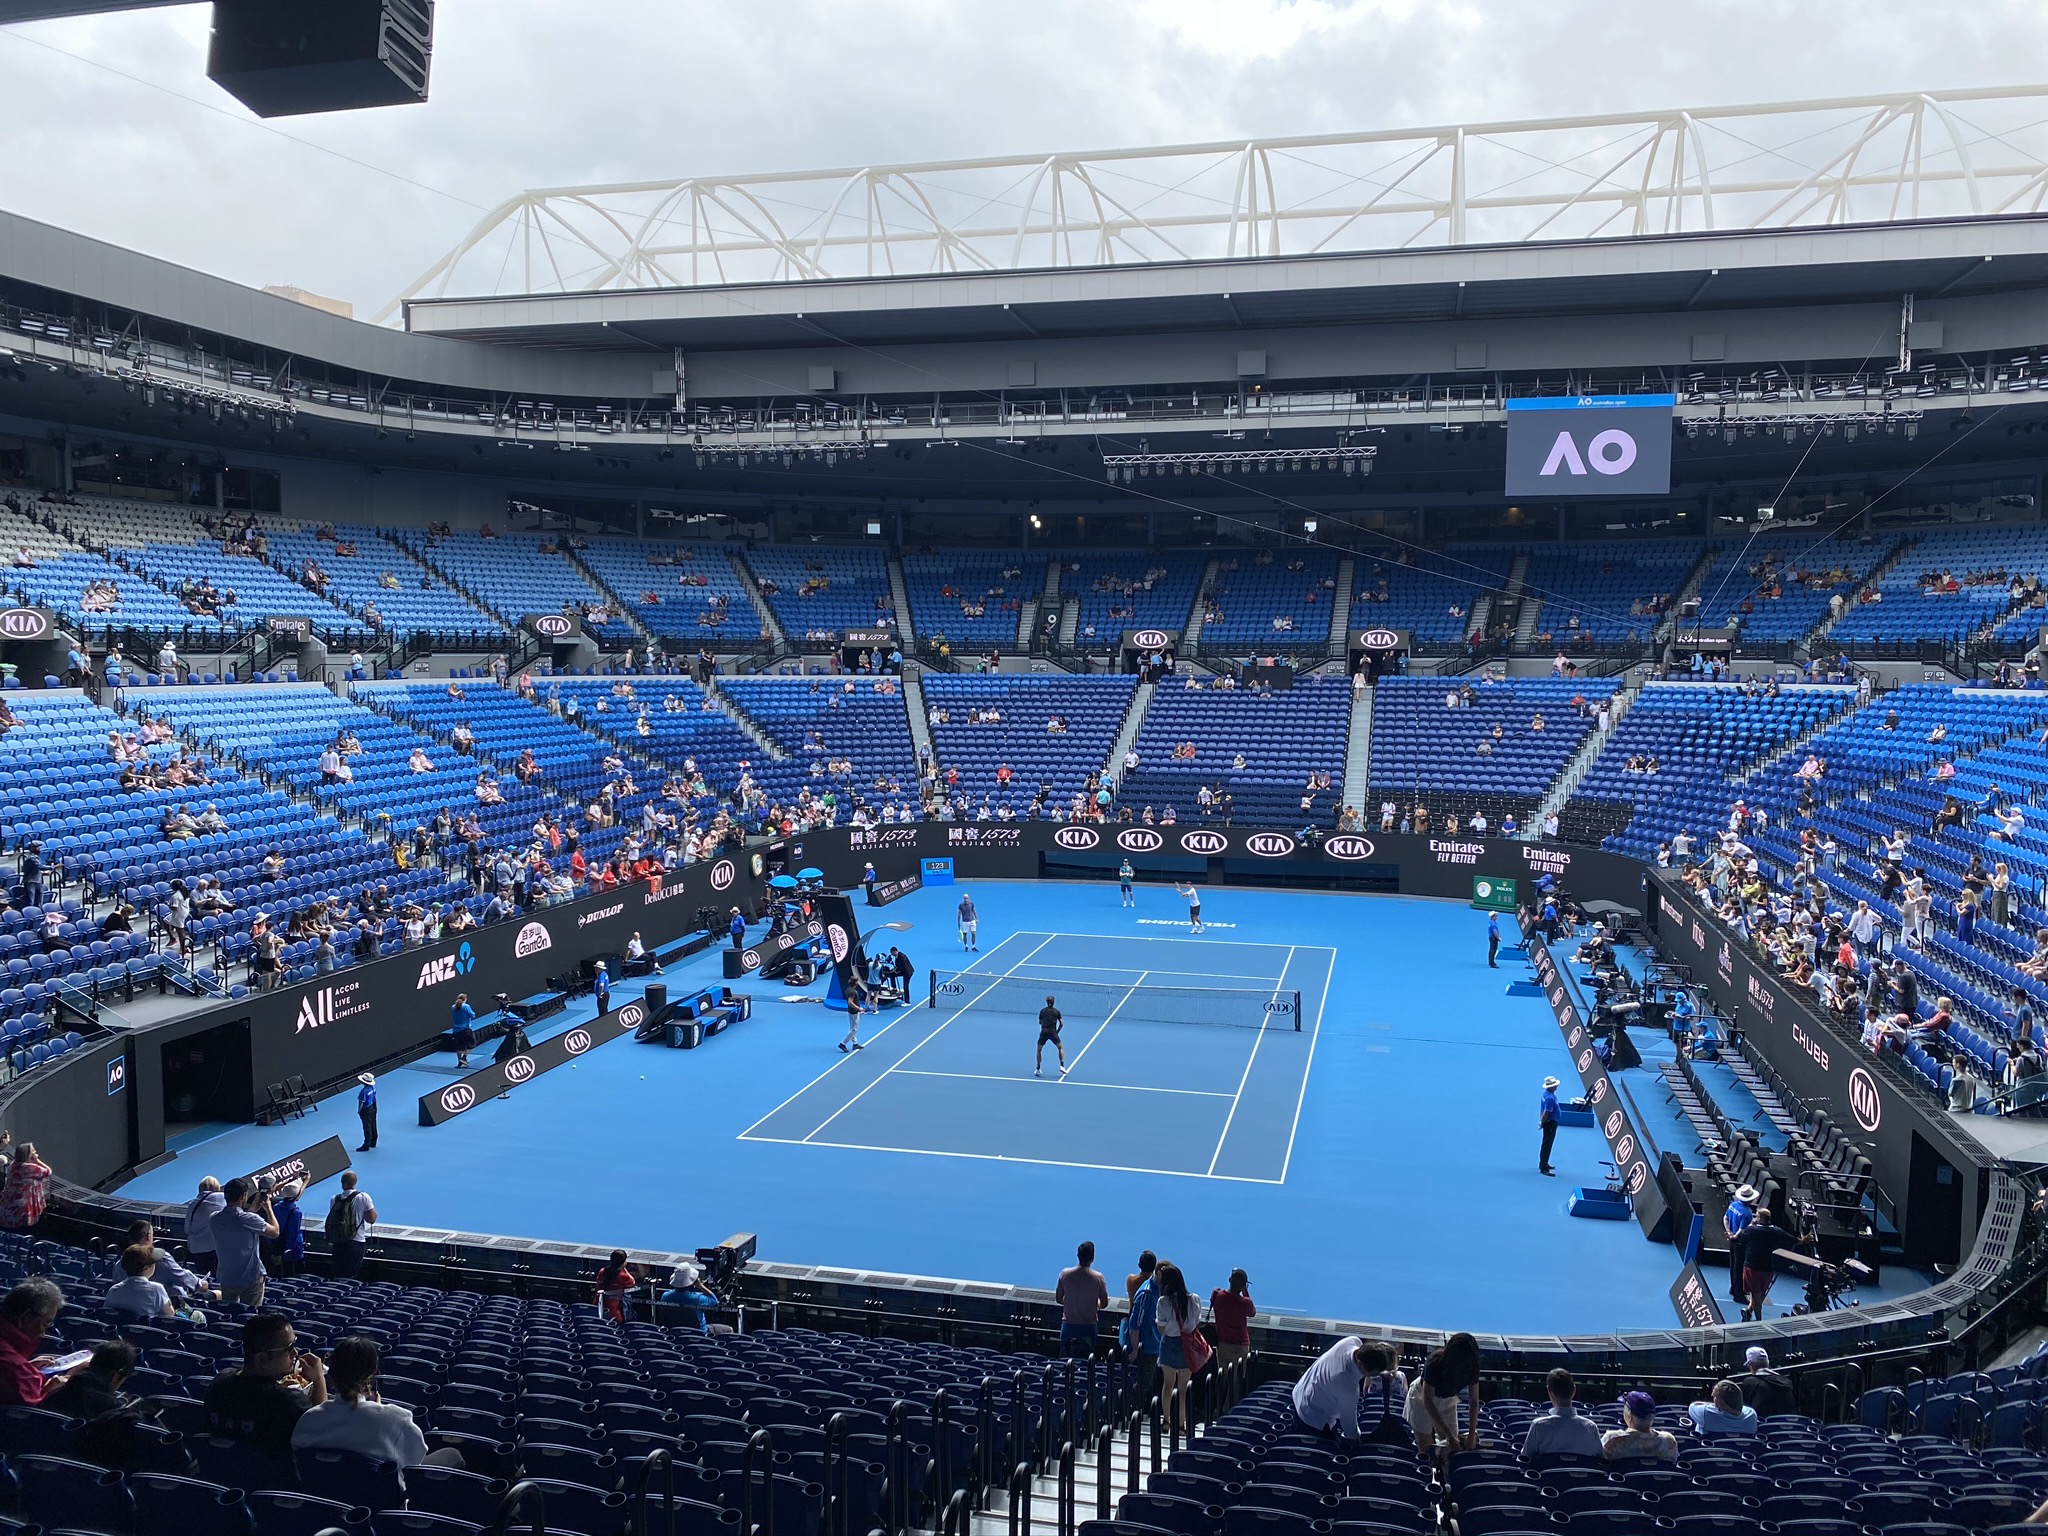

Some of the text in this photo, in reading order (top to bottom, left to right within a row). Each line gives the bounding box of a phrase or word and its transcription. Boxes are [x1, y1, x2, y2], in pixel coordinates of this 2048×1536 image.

[1577, 398, 1592, 406] AO
[1539, 428, 1637, 476] AO
[4, 616, 38, 632] KIA
[542, 620, 566, 632] KIA
[1139, 634, 1162, 644] KIA
[1367, 634, 1392, 644] KIA
[880, 828, 917, 842] 1573
[980, 828, 1020, 840] 1573
[1062, 832, 1092, 844] KIA
[1125, 834, 1155, 847] KIA
[1188, 836, 1220, 849] KIA
[1254, 838, 1286, 852] KIA
[1334, 840, 1366, 854] KIA
[1429, 840, 1485, 854] Emirates
[1438, 852, 1476, 864] FLY BETTER
[1522, 846, 1570, 864] Emirates
[1530, 860, 1564, 874] FLY BETTER
[714, 866, 730, 885] KIA
[586, 904, 624, 924] DUNLOP
[810, 924, 821, 934] KIA
[1136, 918, 1236, 928] MELOURNE
[522, 926, 542, 940] 百岁山
[744, 952, 758, 966] KIA
[416, 954, 456, 990] ANZ
[334, 982, 360, 996] ACCOR
[335, 996, 350, 1008] LIVE
[1758, 988, 1774, 1010] 1573
[336, 1002, 370, 1020] LIMITLESS
[621, 1008, 640, 1025] KIA
[568, 1034, 590, 1050] KIA
[1792, 1024, 1828, 1071] CHUBB
[110, 1066, 123, 1084] AO
[508, 1060, 532, 1079] KIA
[445, 1088, 471, 1108] KIA
[1854, 1076, 1874, 1124] KIA
[1694, 1304, 1716, 1327] 157
